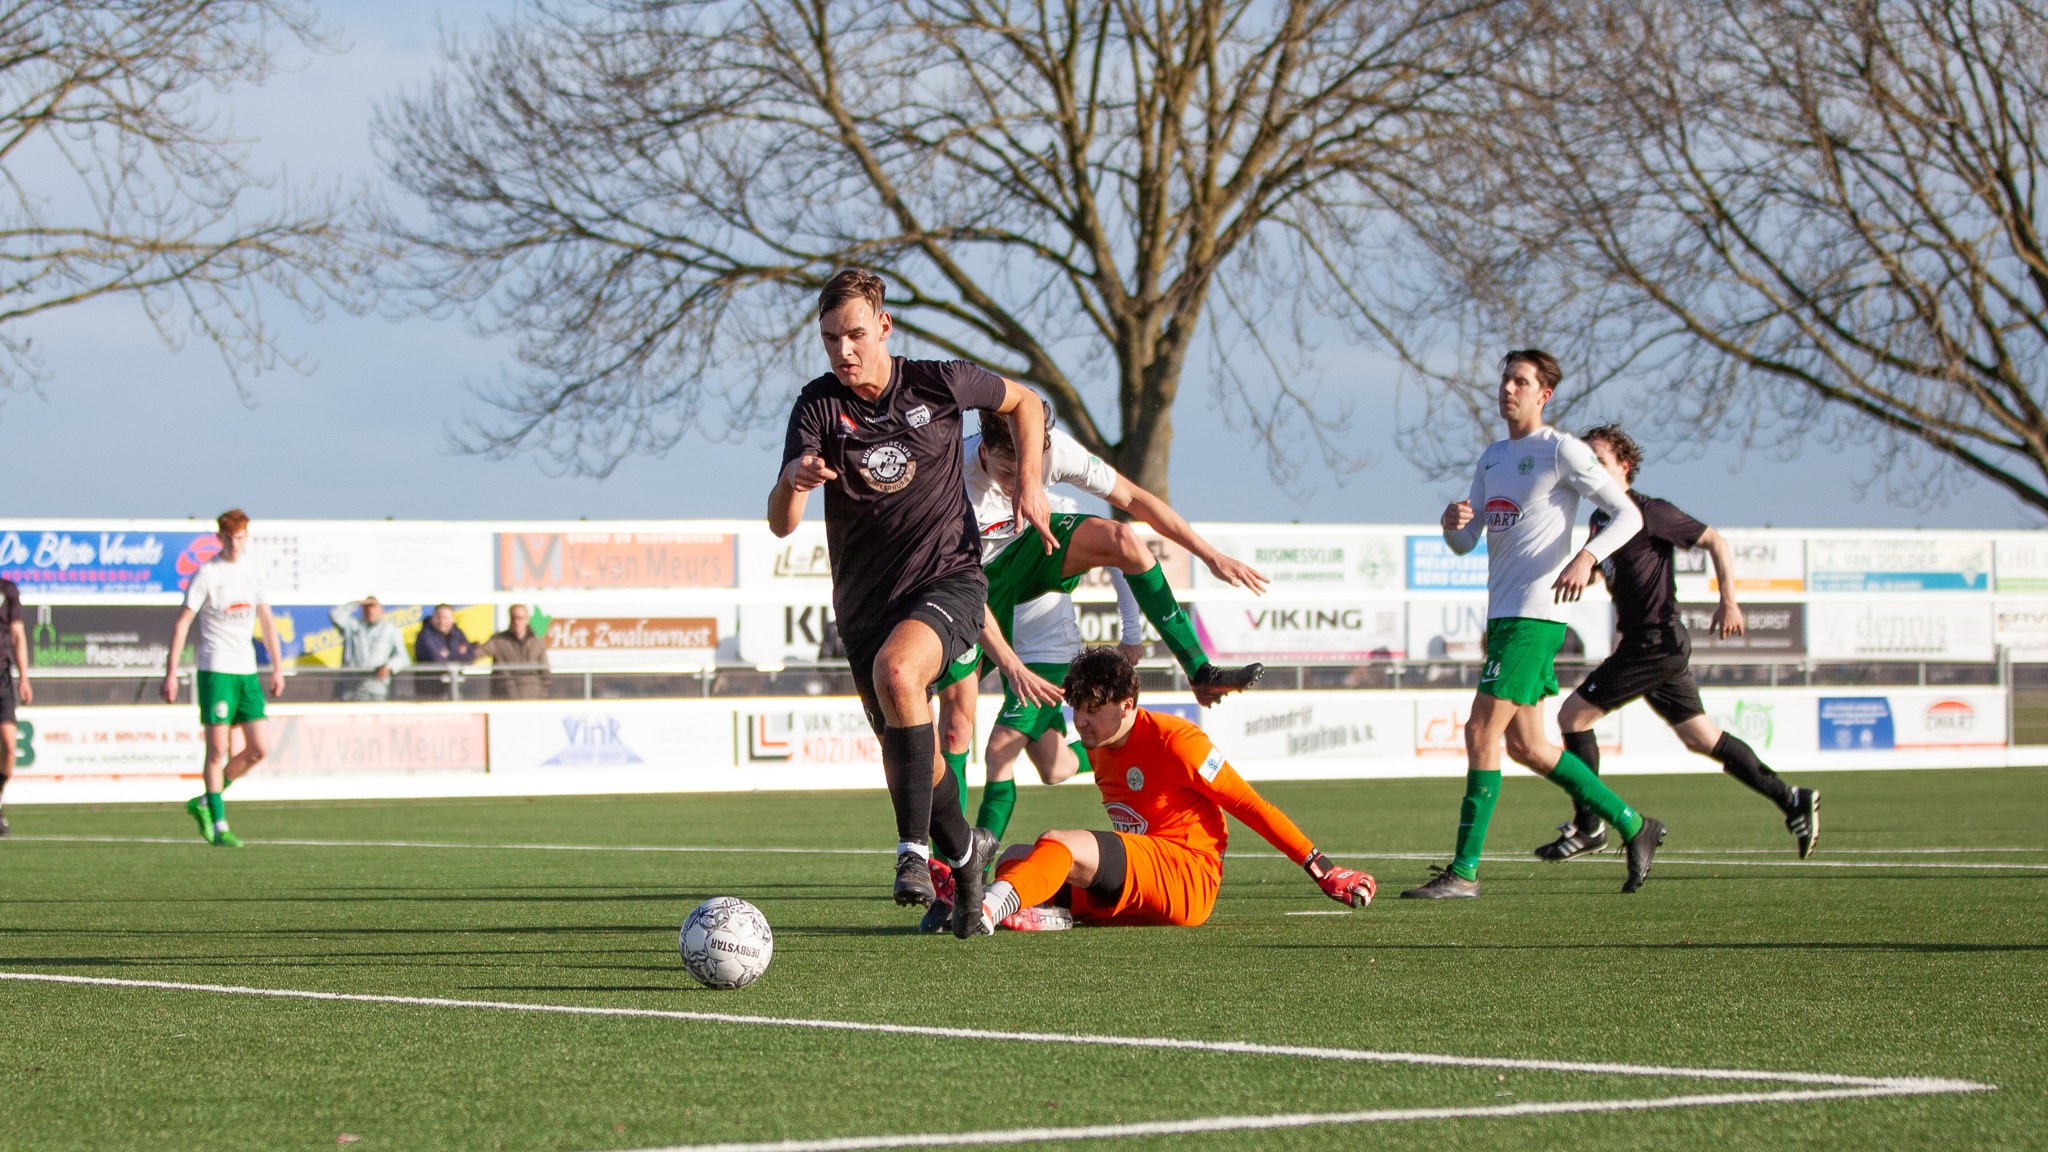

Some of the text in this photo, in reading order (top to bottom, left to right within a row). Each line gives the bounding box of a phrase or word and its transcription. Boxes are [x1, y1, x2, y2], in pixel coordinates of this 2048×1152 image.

[597, 556, 638, 580] van
[645, 546, 722, 580] Meurs
[551, 618, 711, 648] Het Zwaluwnest
[1245, 608, 1363, 631] VIKING
[1856, 605, 1947, 642] dennis
[1486, 660, 1501, 678] 14
[561, 714, 624, 746] Vink
[803, 712, 832, 732] VAN
[1244, 704, 1314, 738] autobedrijf
[336, 736, 382, 764] van
[389, 727, 471, 764] Meurs
[711, 938, 760, 958] DERBYSTAR
